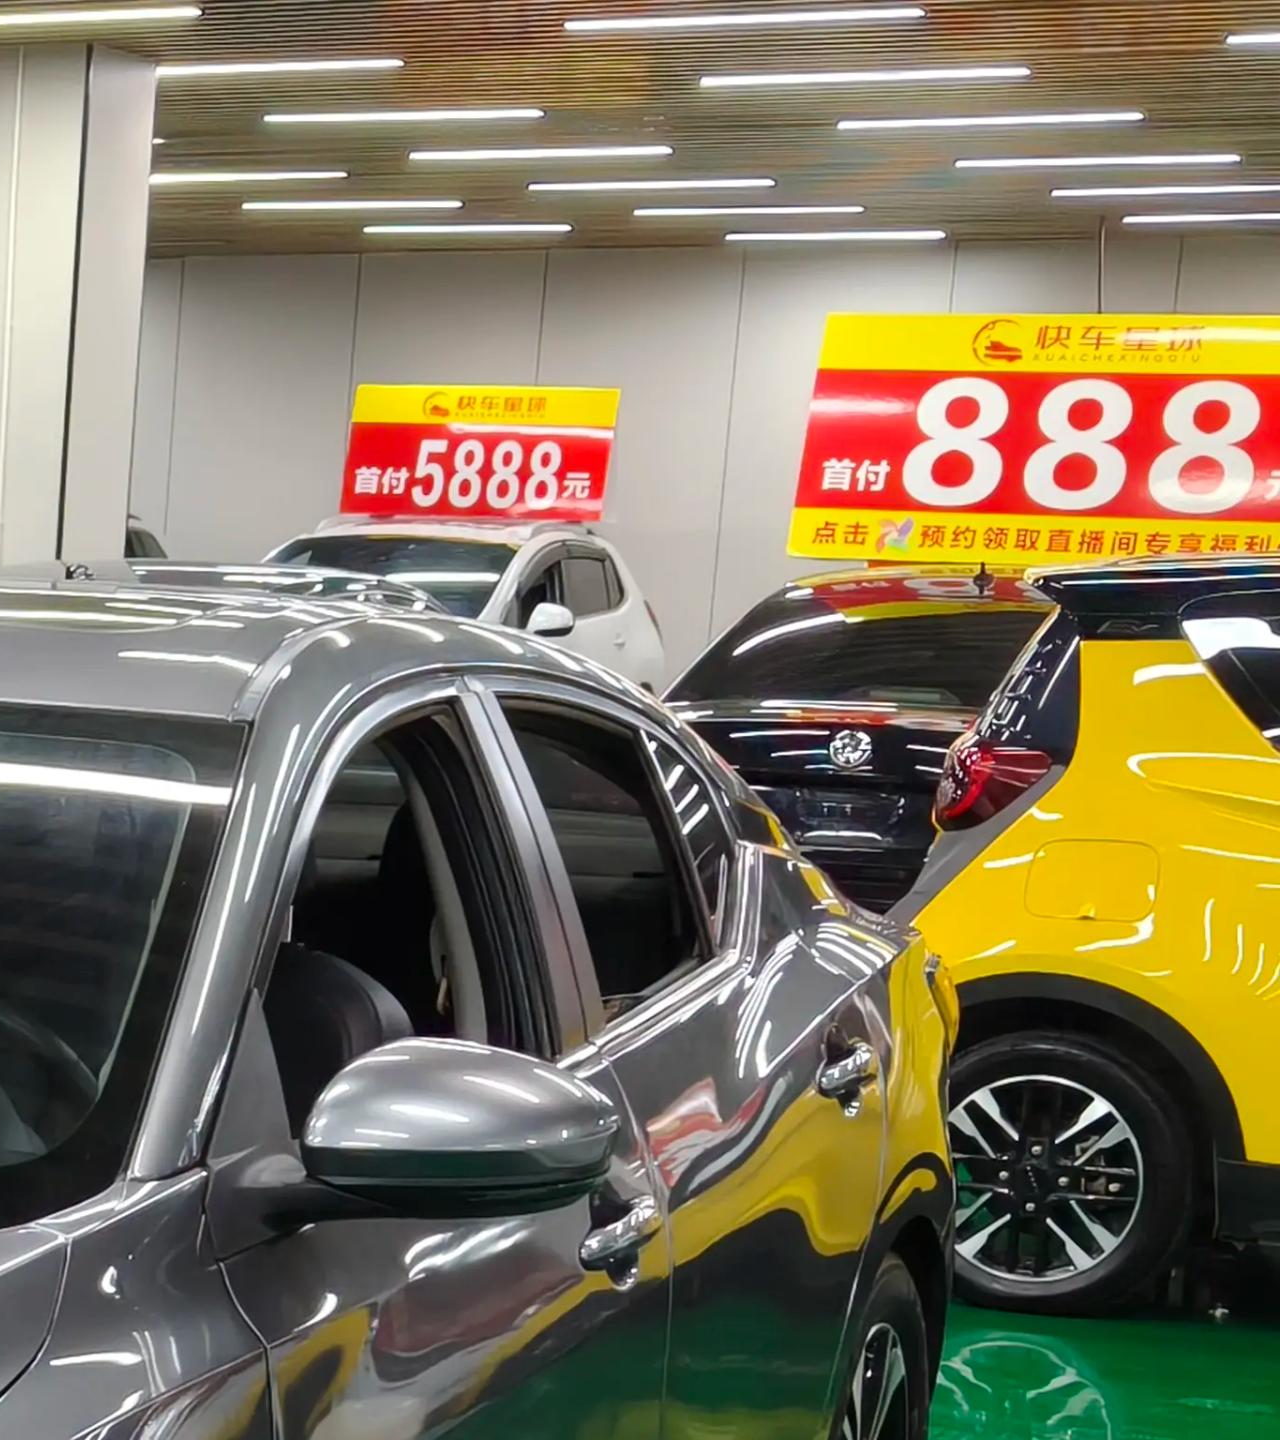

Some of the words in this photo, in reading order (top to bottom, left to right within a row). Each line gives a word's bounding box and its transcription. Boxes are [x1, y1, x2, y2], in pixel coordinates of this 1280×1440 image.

[1034, 325, 1206, 352] 快车星球
[354, 439, 591, 509] 首付5888元
[811, 520, 870, 547] 点击
[917, 523, 1280, 555] 预约领取直播间专享福利
